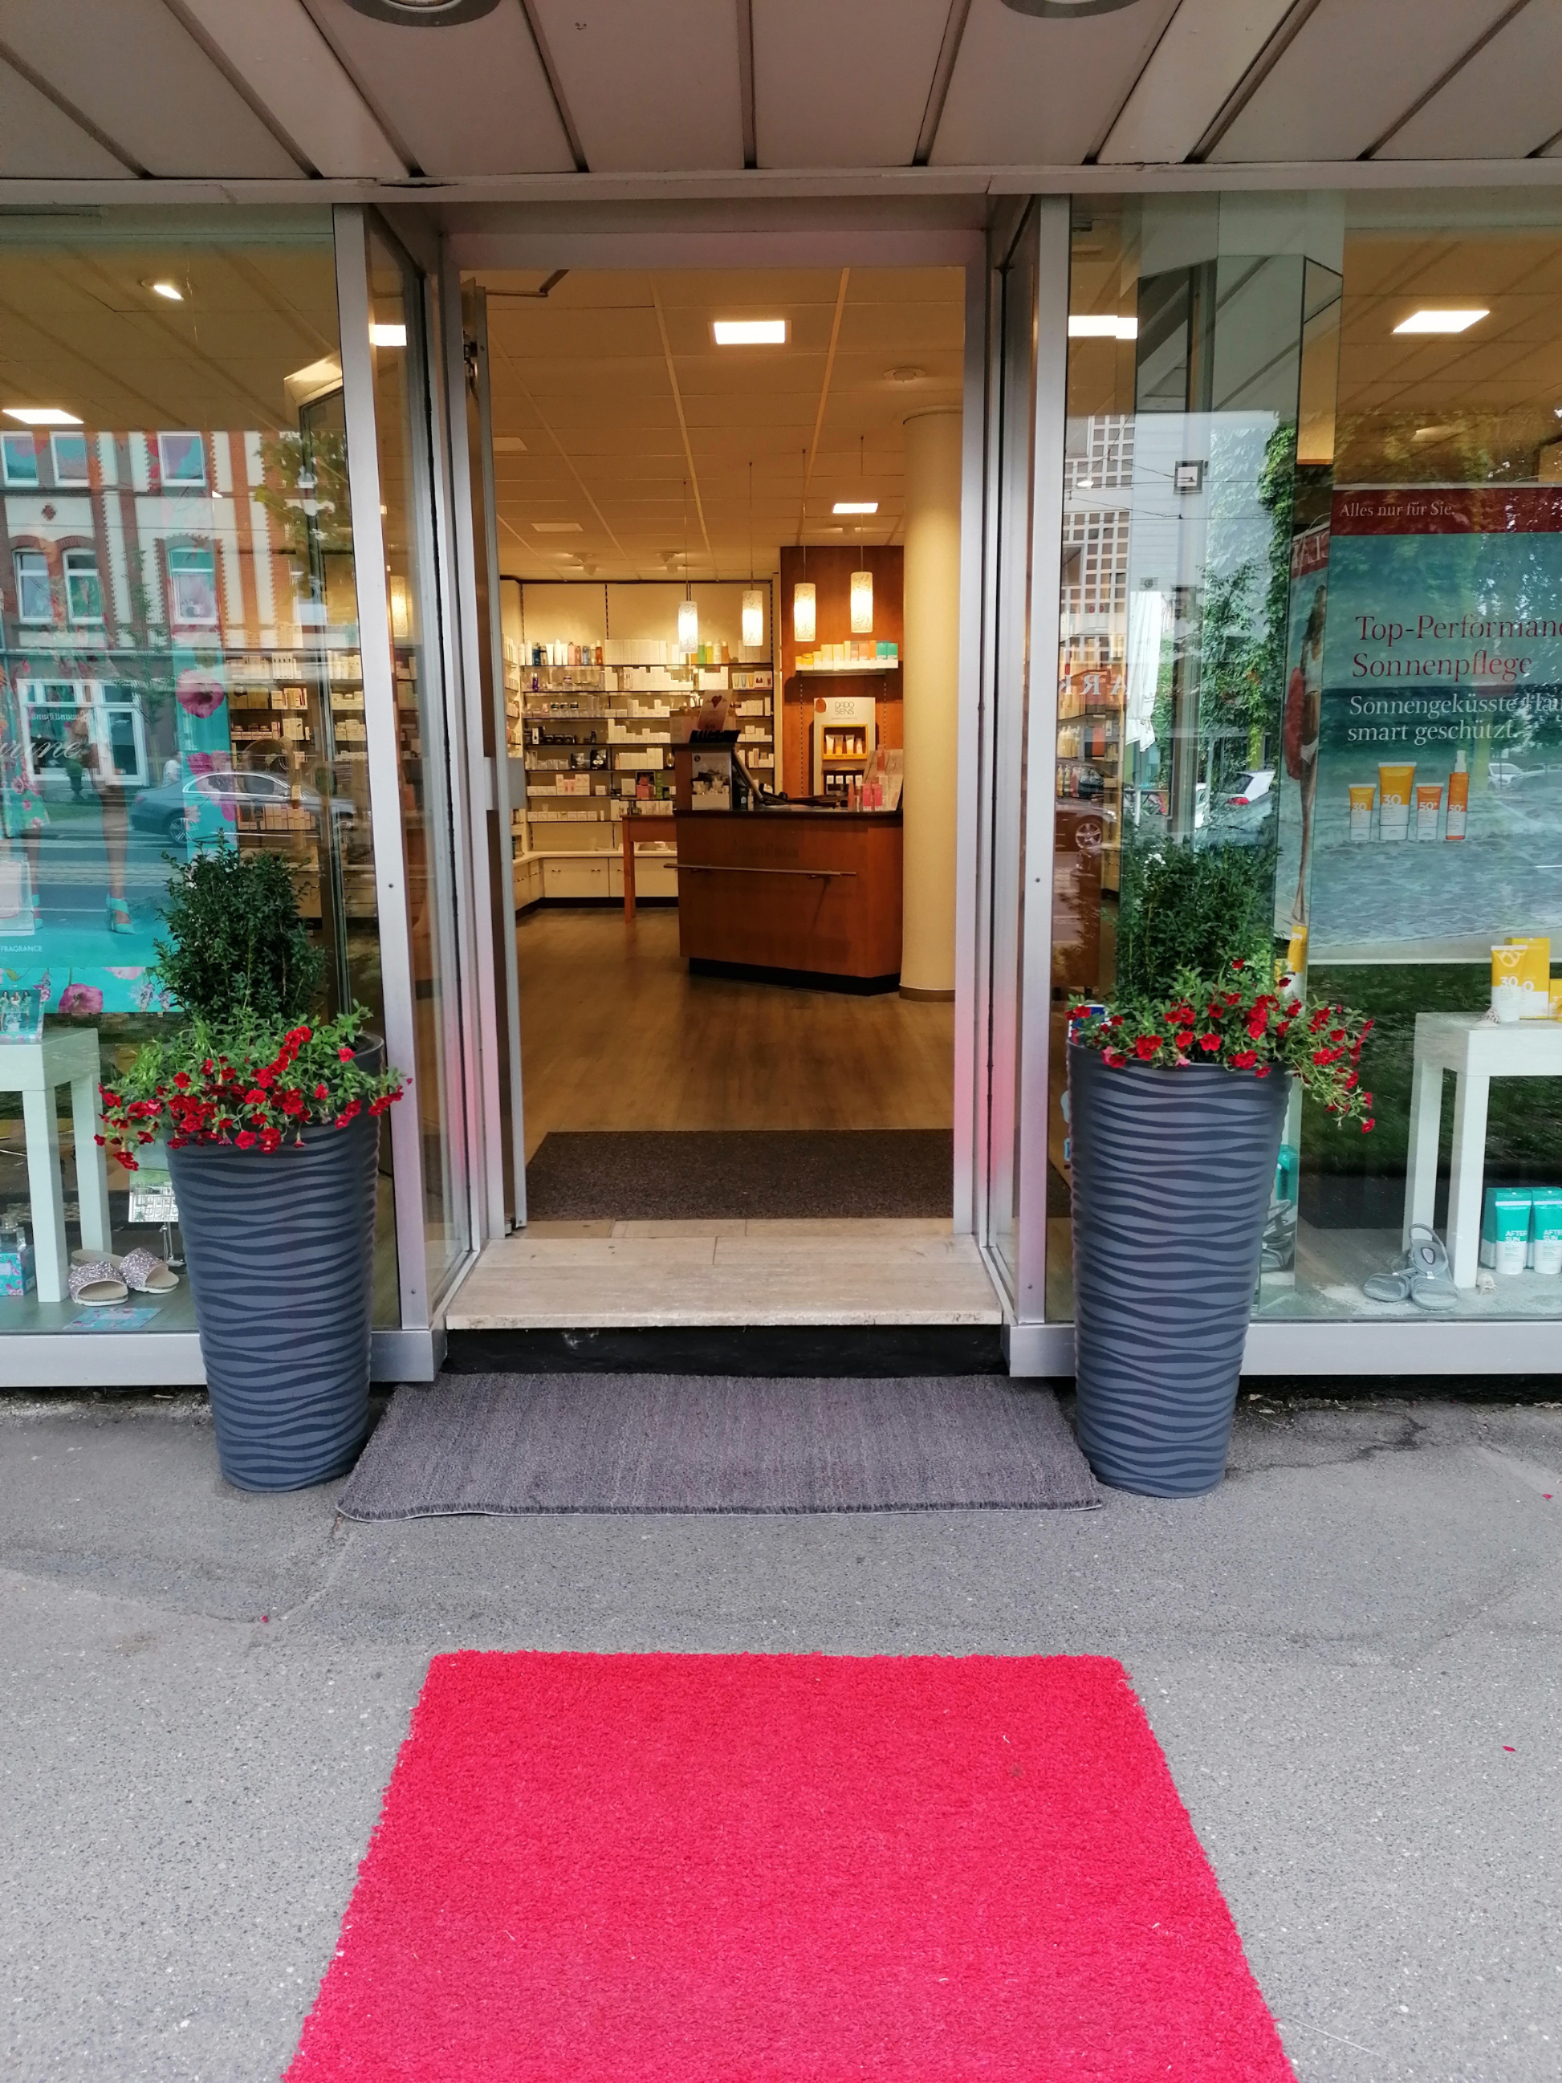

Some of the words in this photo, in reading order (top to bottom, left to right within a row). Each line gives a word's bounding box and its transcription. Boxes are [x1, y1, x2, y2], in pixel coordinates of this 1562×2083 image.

[1339, 502, 1374, 517] Alles
[1377, 505, 1403, 516] nur
[1405, 501, 1425, 516] für
[1355, 614, 1562, 648] Top-Performan
[1352, 649, 1533, 683] Sonnenpflege
[834, 708, 855, 716] SENS
[1350, 692, 1516, 719] Sonnengeküsste
[1347, 725, 1409, 742] smart
[1352, 802, 1368, 812] 30
[1382, 793, 1402, 806] 30
[1500, 975, 1519, 988] 30
